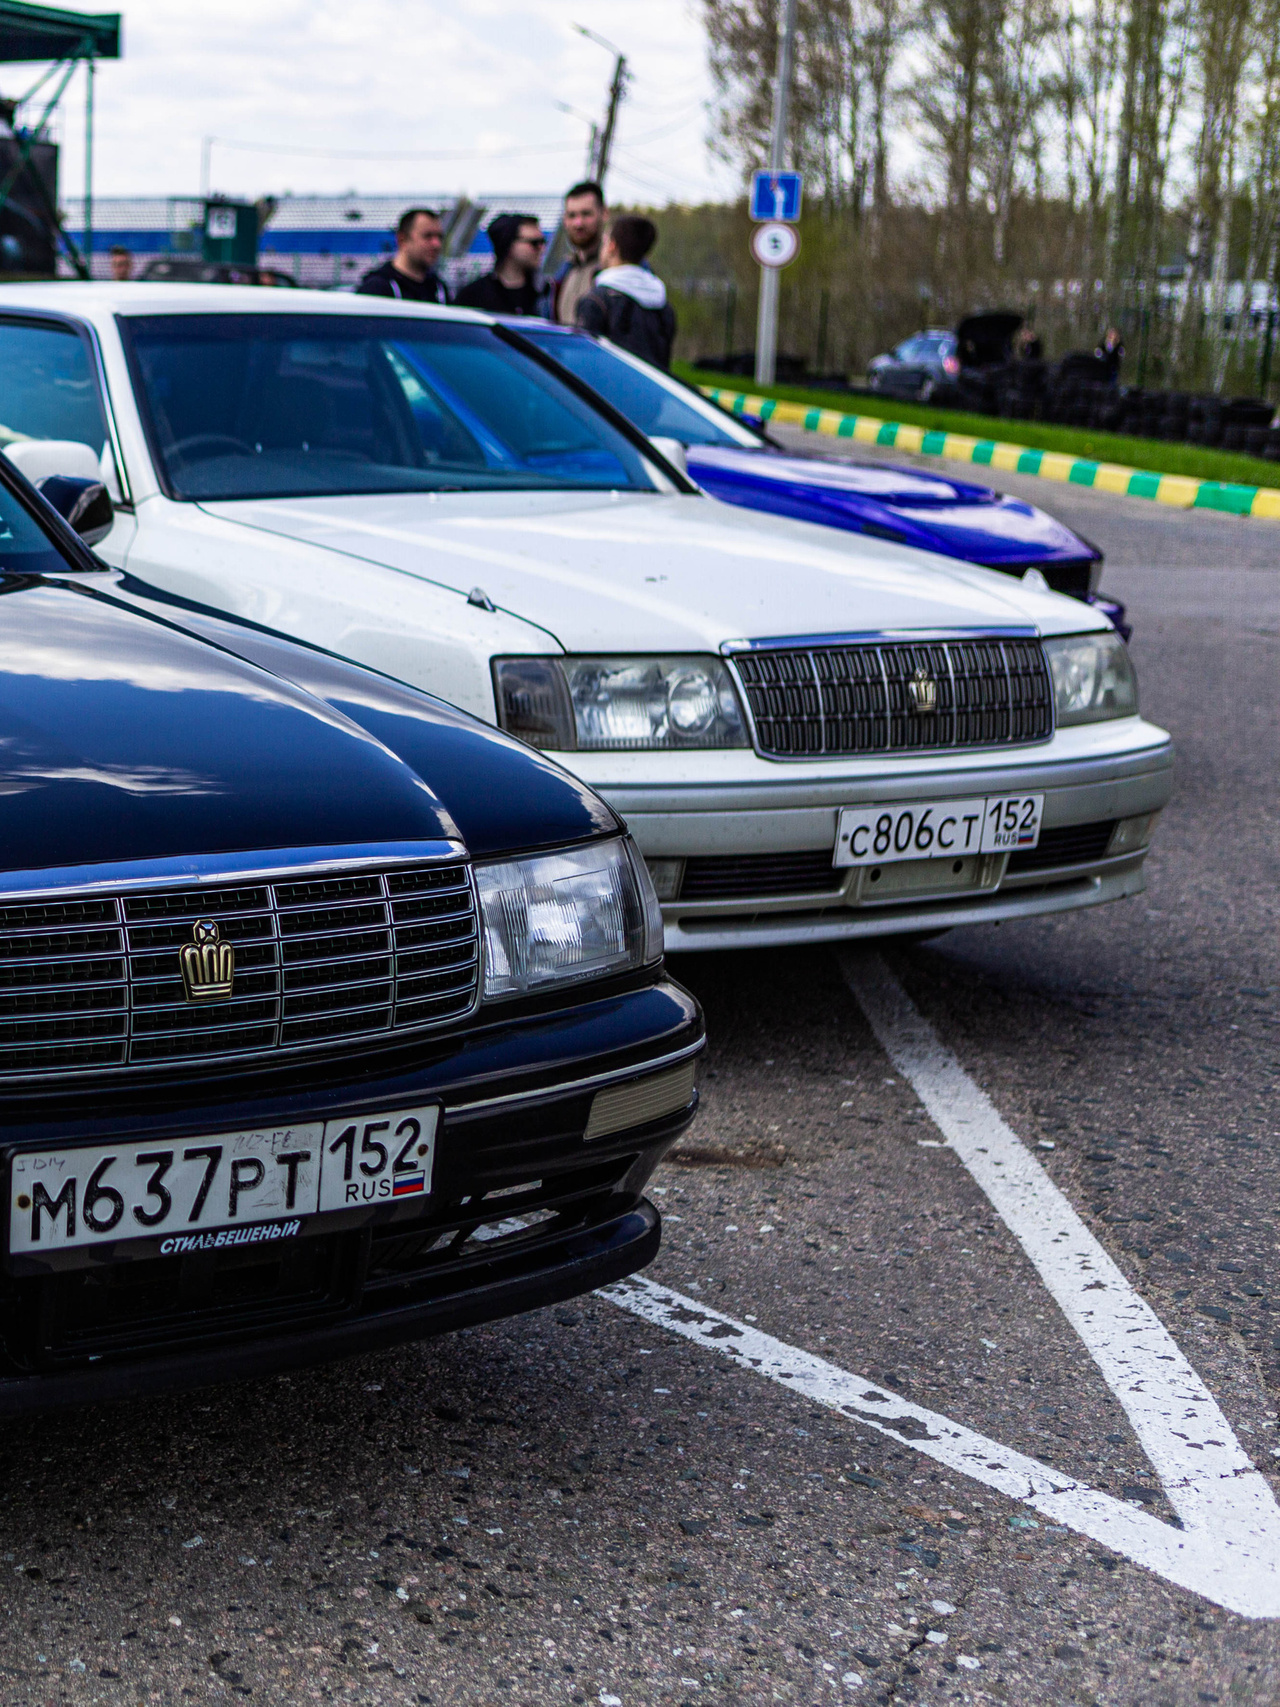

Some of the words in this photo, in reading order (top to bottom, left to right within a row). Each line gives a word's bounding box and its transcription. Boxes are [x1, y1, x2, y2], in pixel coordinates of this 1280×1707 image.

[850, 808, 980, 858] С806СТ
[989, 798, 1035, 833] 152
[993, 831, 1018, 847] RUS
[30, 1145, 312, 1242] М637РТ
[328, 1117, 421, 1182] 152
[345, 1178, 391, 1203] RUS
